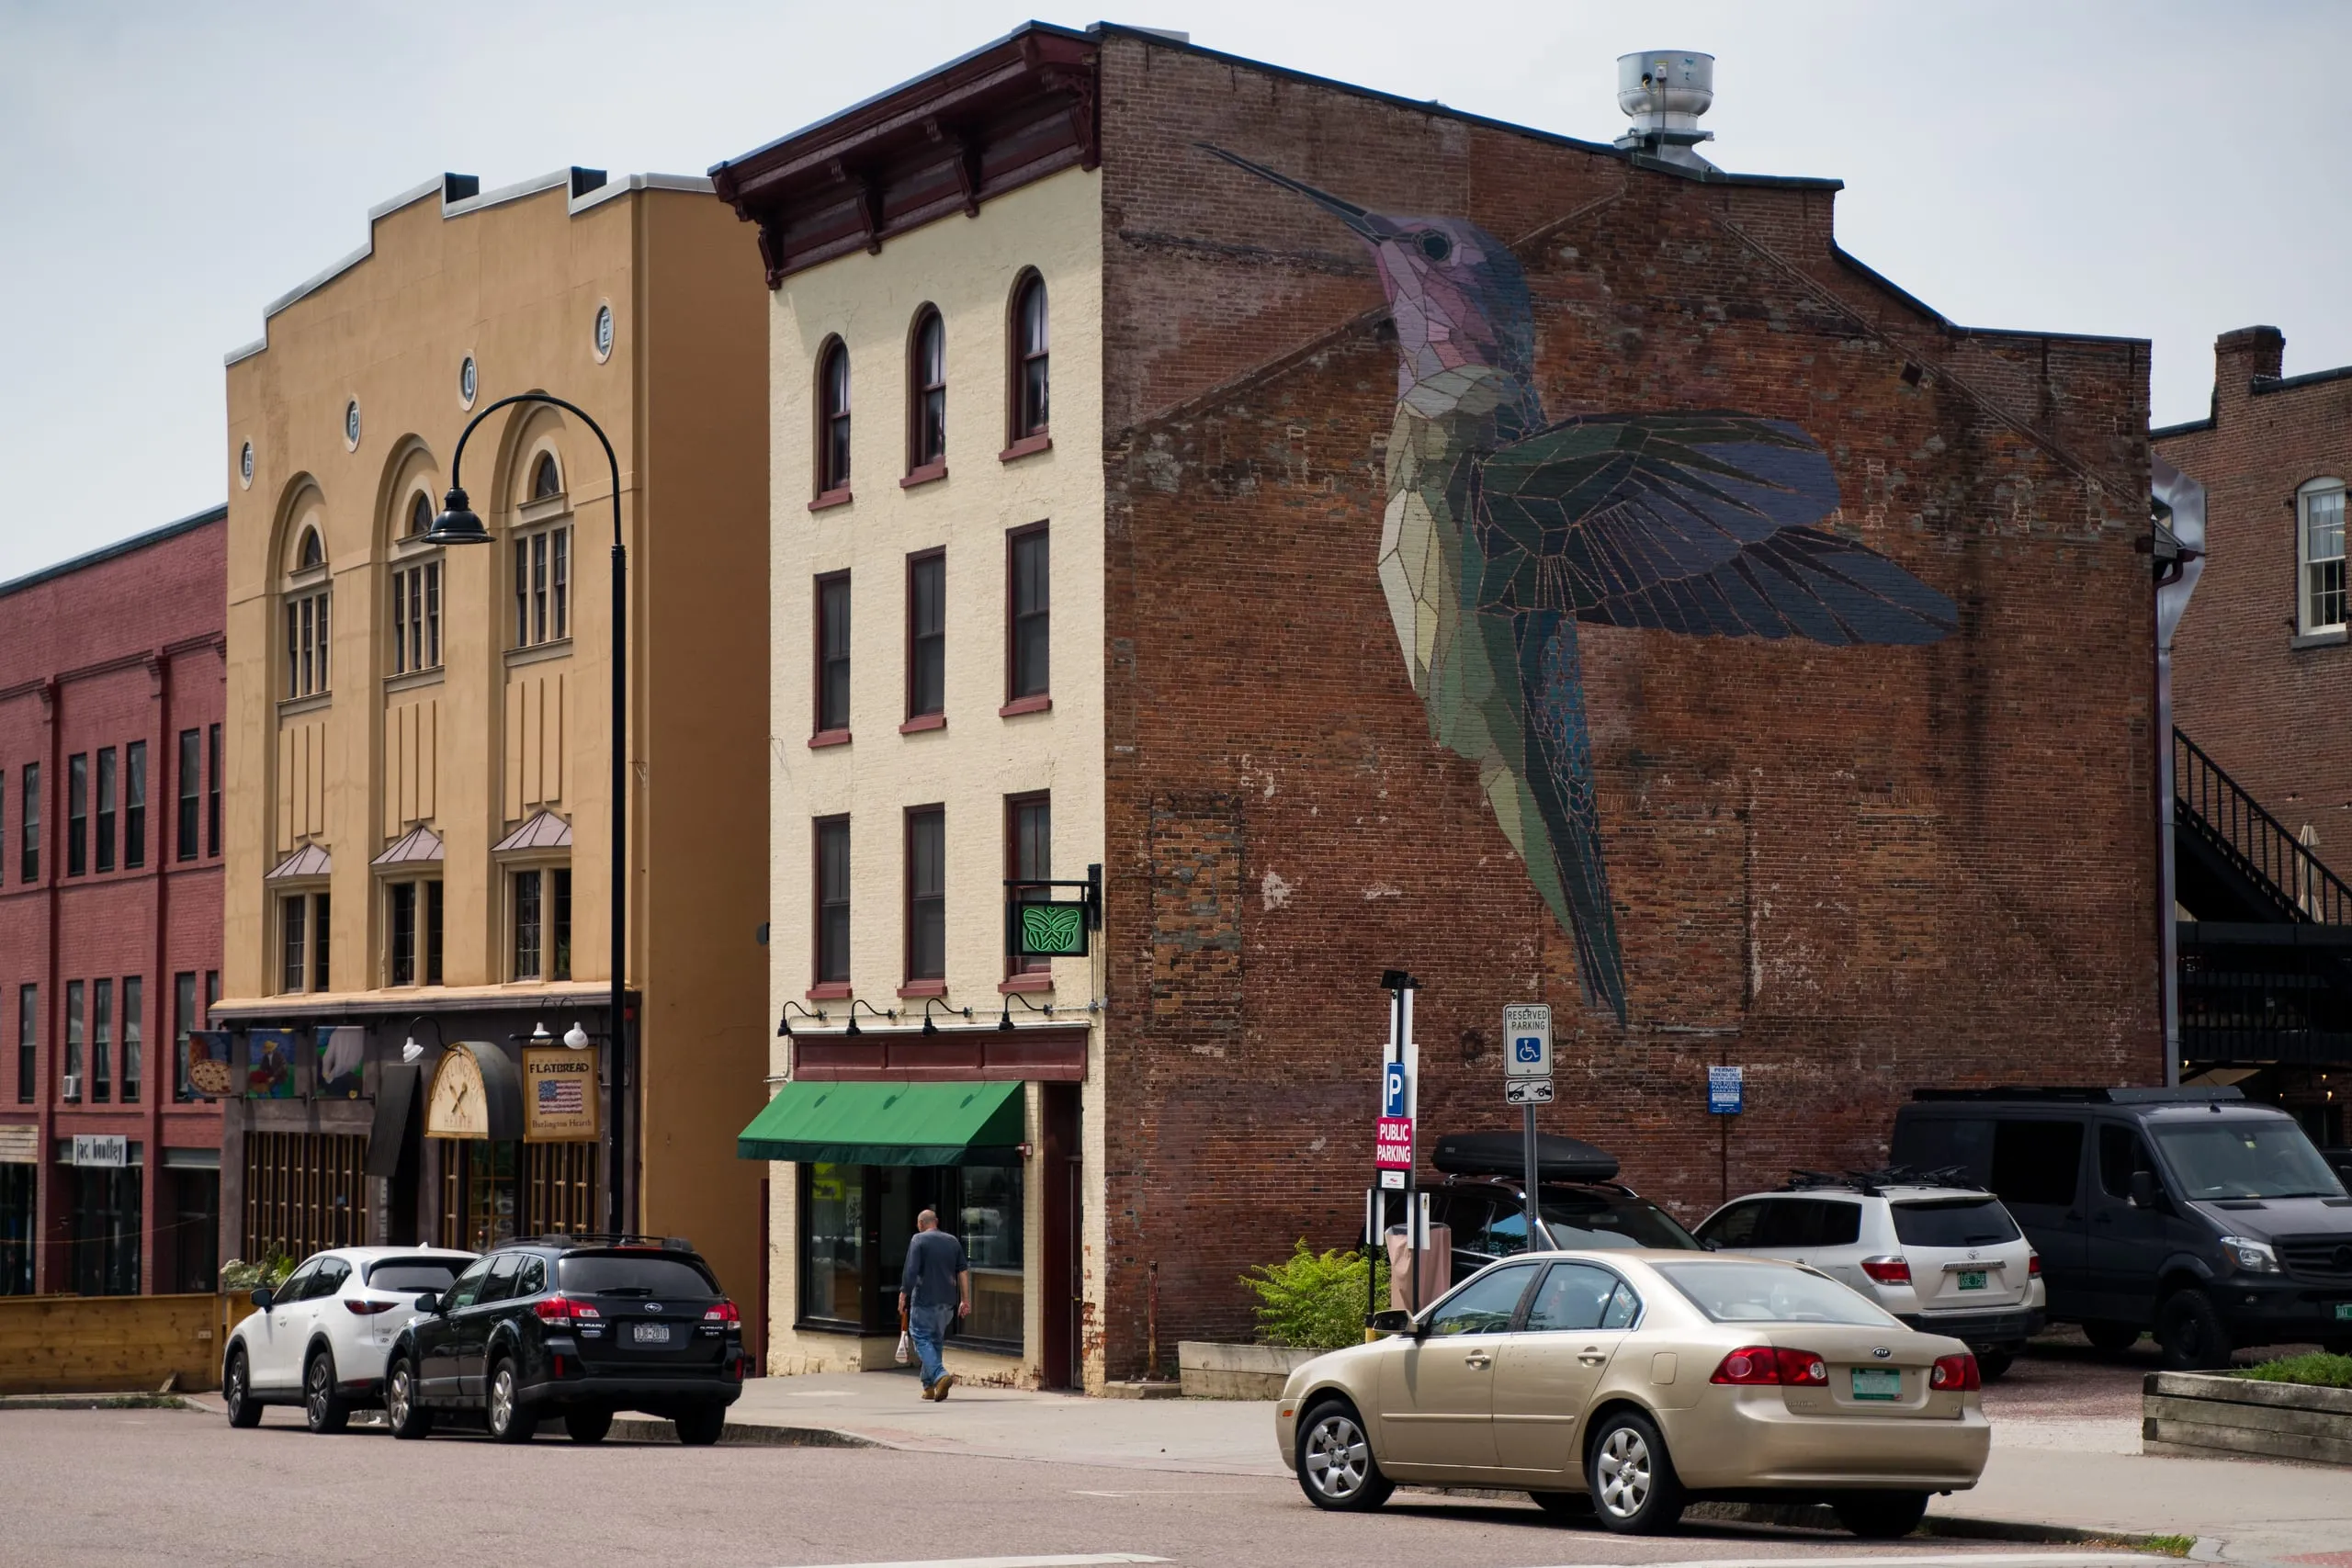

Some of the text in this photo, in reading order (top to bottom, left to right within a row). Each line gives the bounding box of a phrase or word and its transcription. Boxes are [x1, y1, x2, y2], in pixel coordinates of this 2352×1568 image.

[1507, 1010, 1547, 1020] RESERVED
[1511, 1021, 1545, 1030] PARKING
[529, 1063, 589, 1073] FLATBREAD
[1388, 1073, 1402, 1107] P
[1380, 1123, 1409, 1141] PUBLIC
[1377, 1145, 1411, 1163] PARKING
[651, 1328, 669, 1338] 2010
